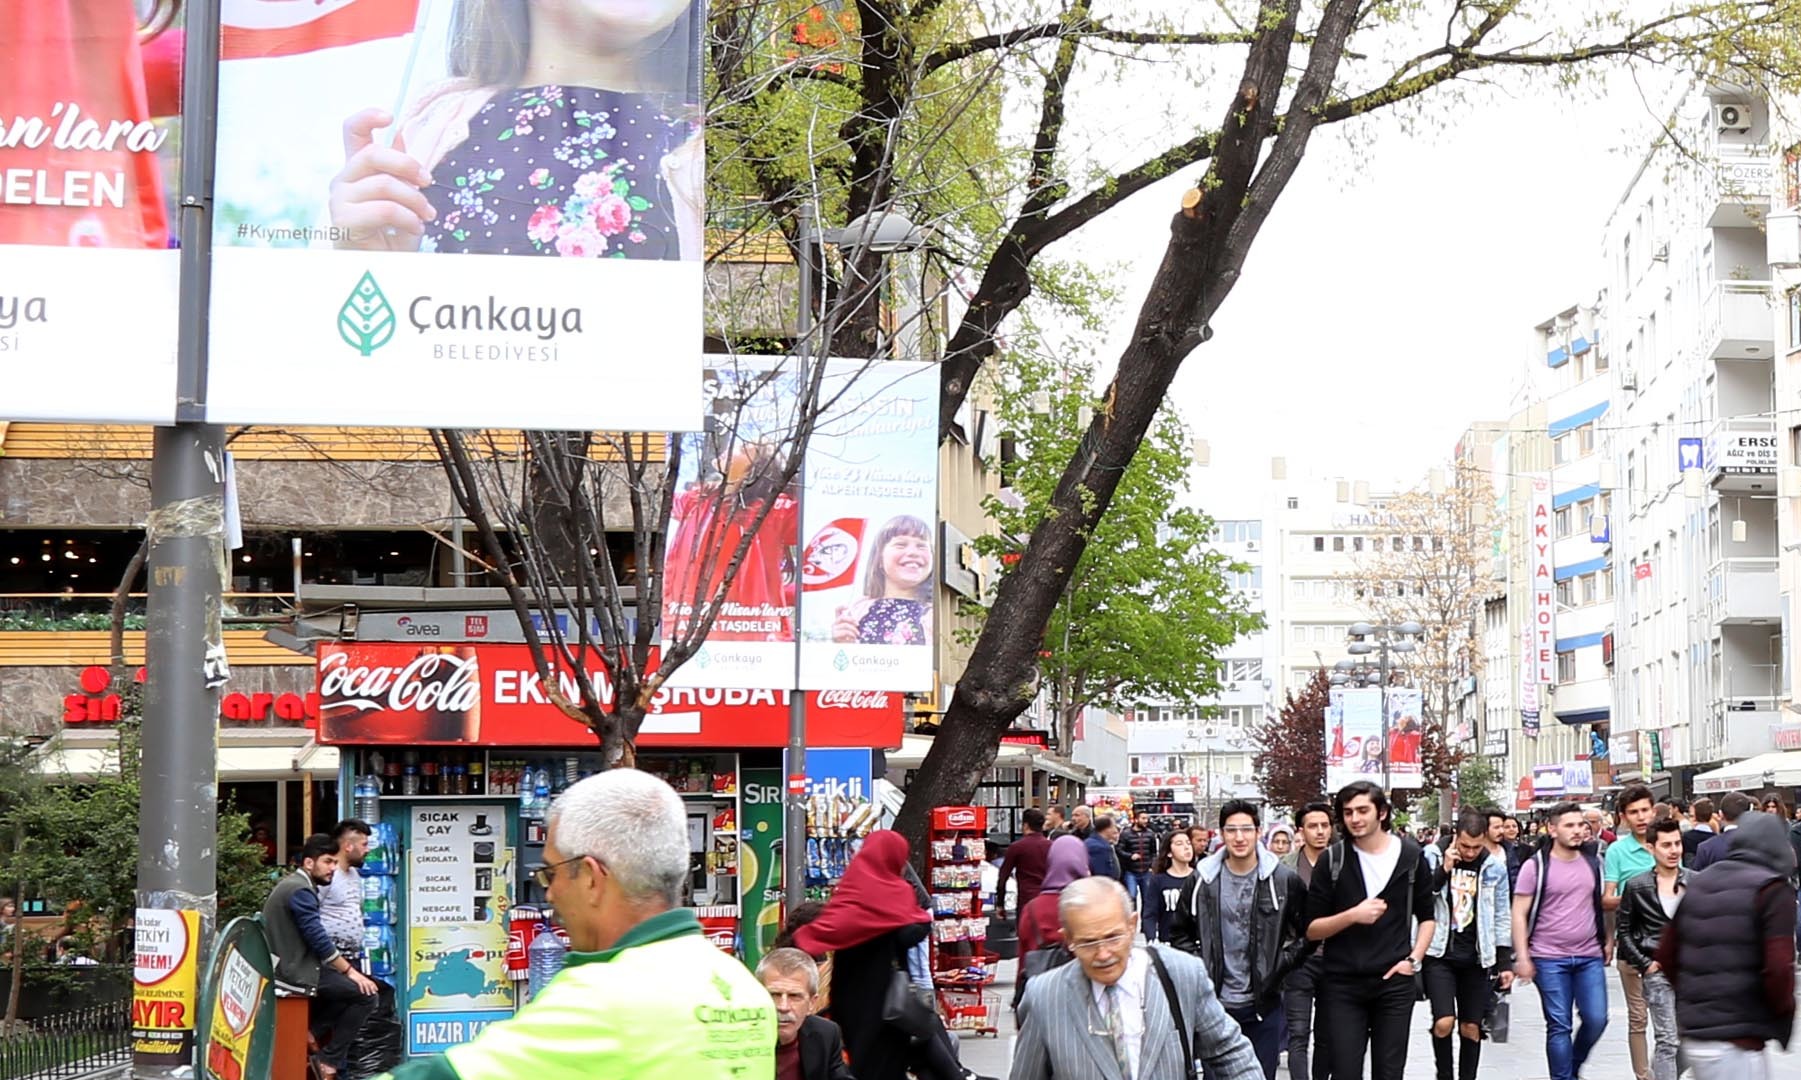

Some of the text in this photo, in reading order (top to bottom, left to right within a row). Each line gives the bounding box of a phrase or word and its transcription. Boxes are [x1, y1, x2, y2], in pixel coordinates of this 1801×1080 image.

[408, 294, 584, 341] Çankaya
[433, 343, 559, 362] BELEDİYESİ
[1534, 503, 1552, 682] AKYA HOTEL
[406, 621, 440, 636] avea
[419, 812, 459, 822] SICAK
[426, 825, 452, 836] ÇAY
[424, 845, 450, 853] SICAK
[416, 855, 459, 864] ÇİKOLATA
[418, 885, 458, 893] NESCAFE
[422, 905, 460, 913] NESCAFE
[415, 1022, 464, 1044] HAZIR
